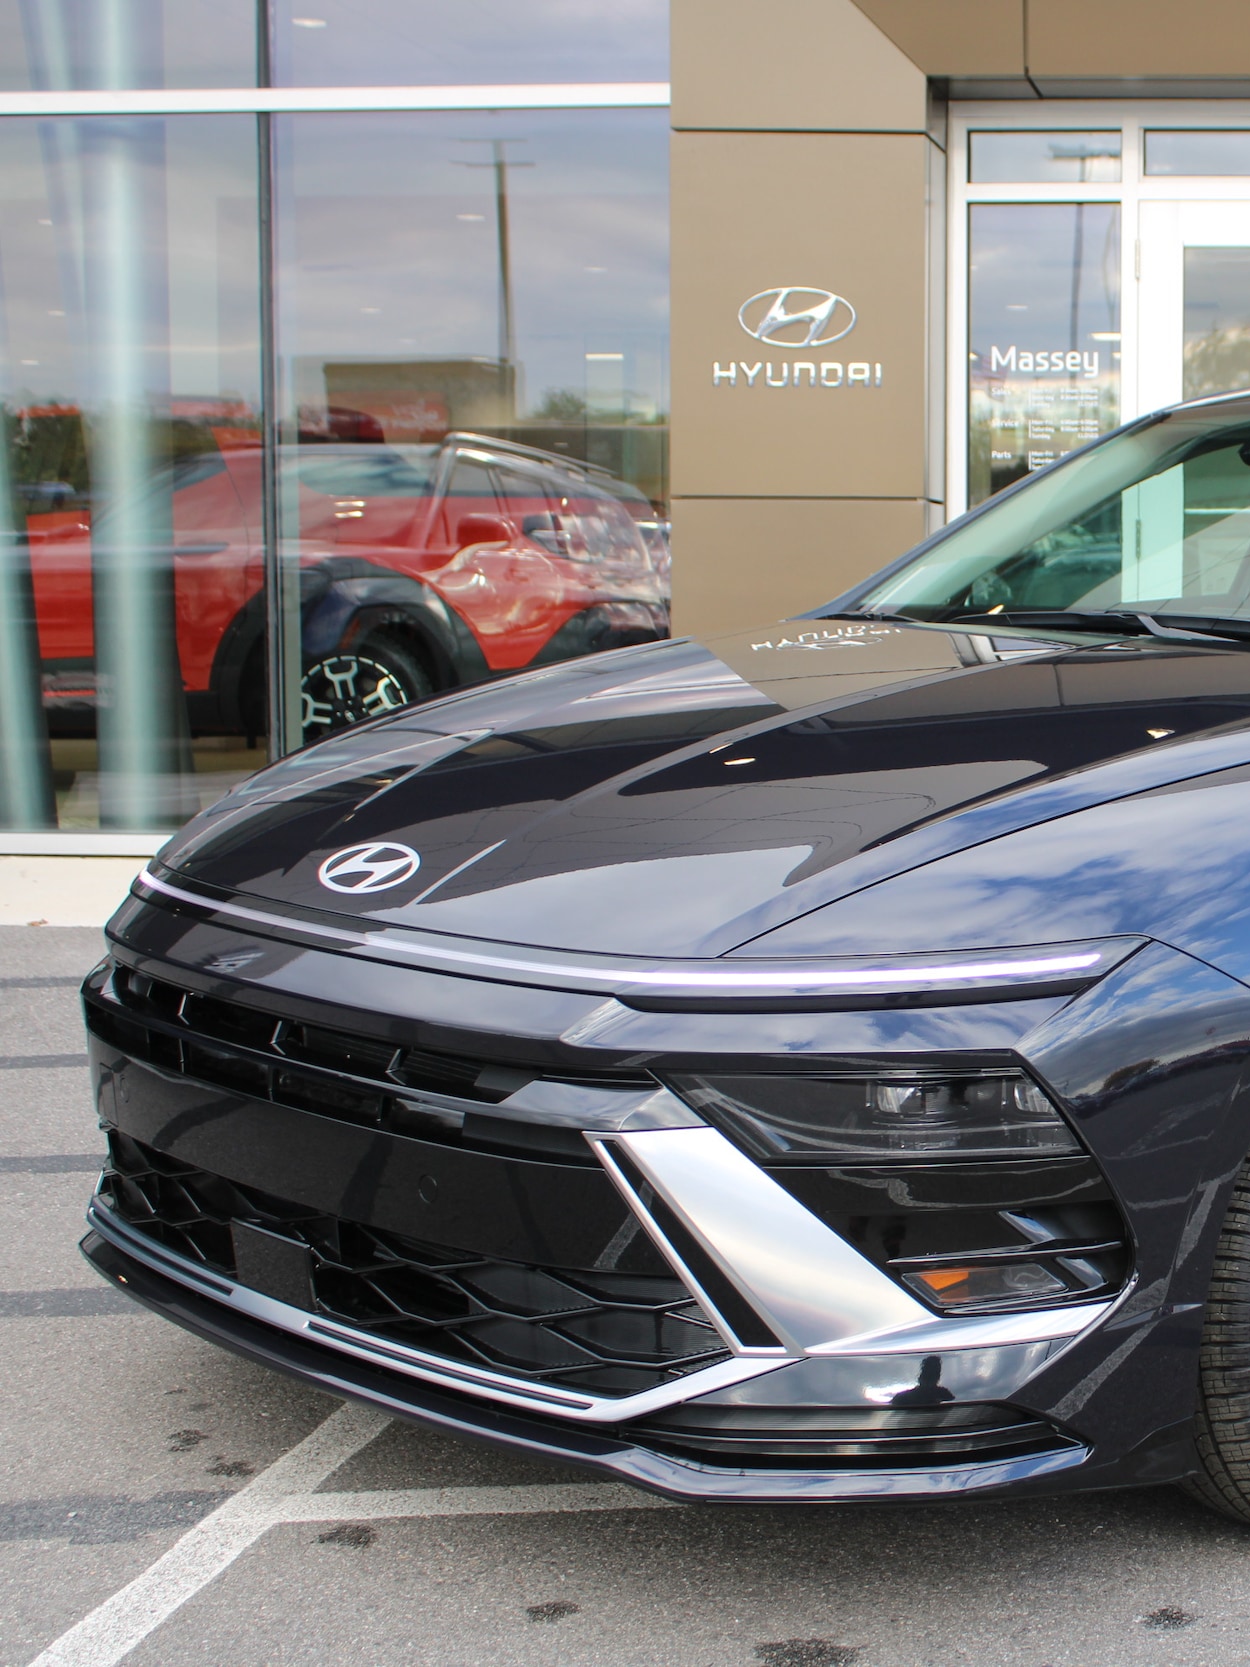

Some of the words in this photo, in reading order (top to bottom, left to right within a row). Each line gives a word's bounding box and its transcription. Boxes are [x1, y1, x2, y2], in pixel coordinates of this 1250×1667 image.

[713, 361, 883, 388] HYUNDAI
[991, 345, 1099, 378] Massey
[991, 450, 1012, 459] Parts
